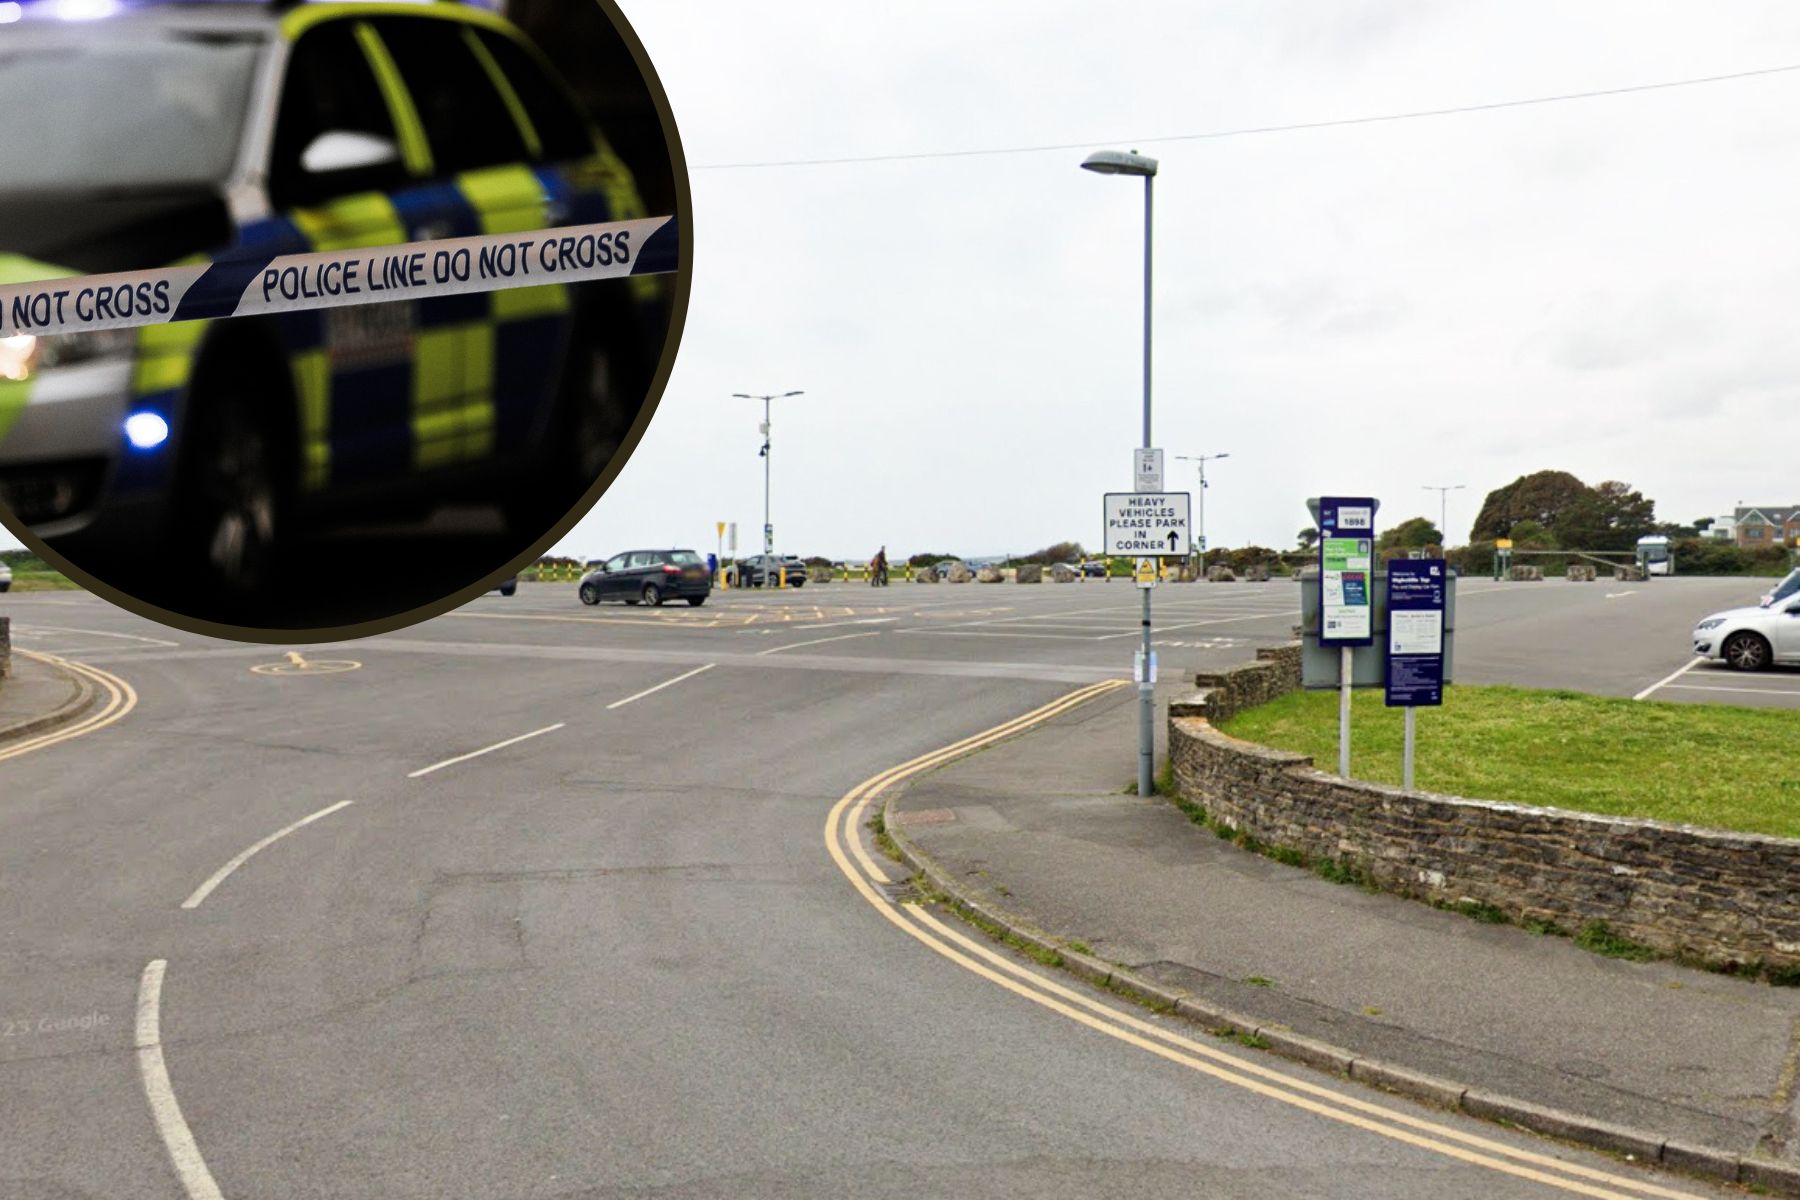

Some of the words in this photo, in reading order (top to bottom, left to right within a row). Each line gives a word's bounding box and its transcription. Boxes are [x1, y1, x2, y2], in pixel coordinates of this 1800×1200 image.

[263, 260, 361, 302] POLICE
[367, 253, 427, 291] LINE
[433, 248, 471, 284] DO
[479, 241, 535, 279] NOT
[539, 230, 630, 272] CROSS
[12, 290, 70, 329] NOT
[75, 279, 170, 322] CROSS
[1128, 498, 1166, 507] HEAVY
[1118, 508, 1175, 517] VEHICLES
[1109, 518, 1152, 528] PLEASE
[1155, 518, 1186, 528] PARK
[1134, 530, 1147, 539] IN
[1115, 540, 1165, 550] CORNER
